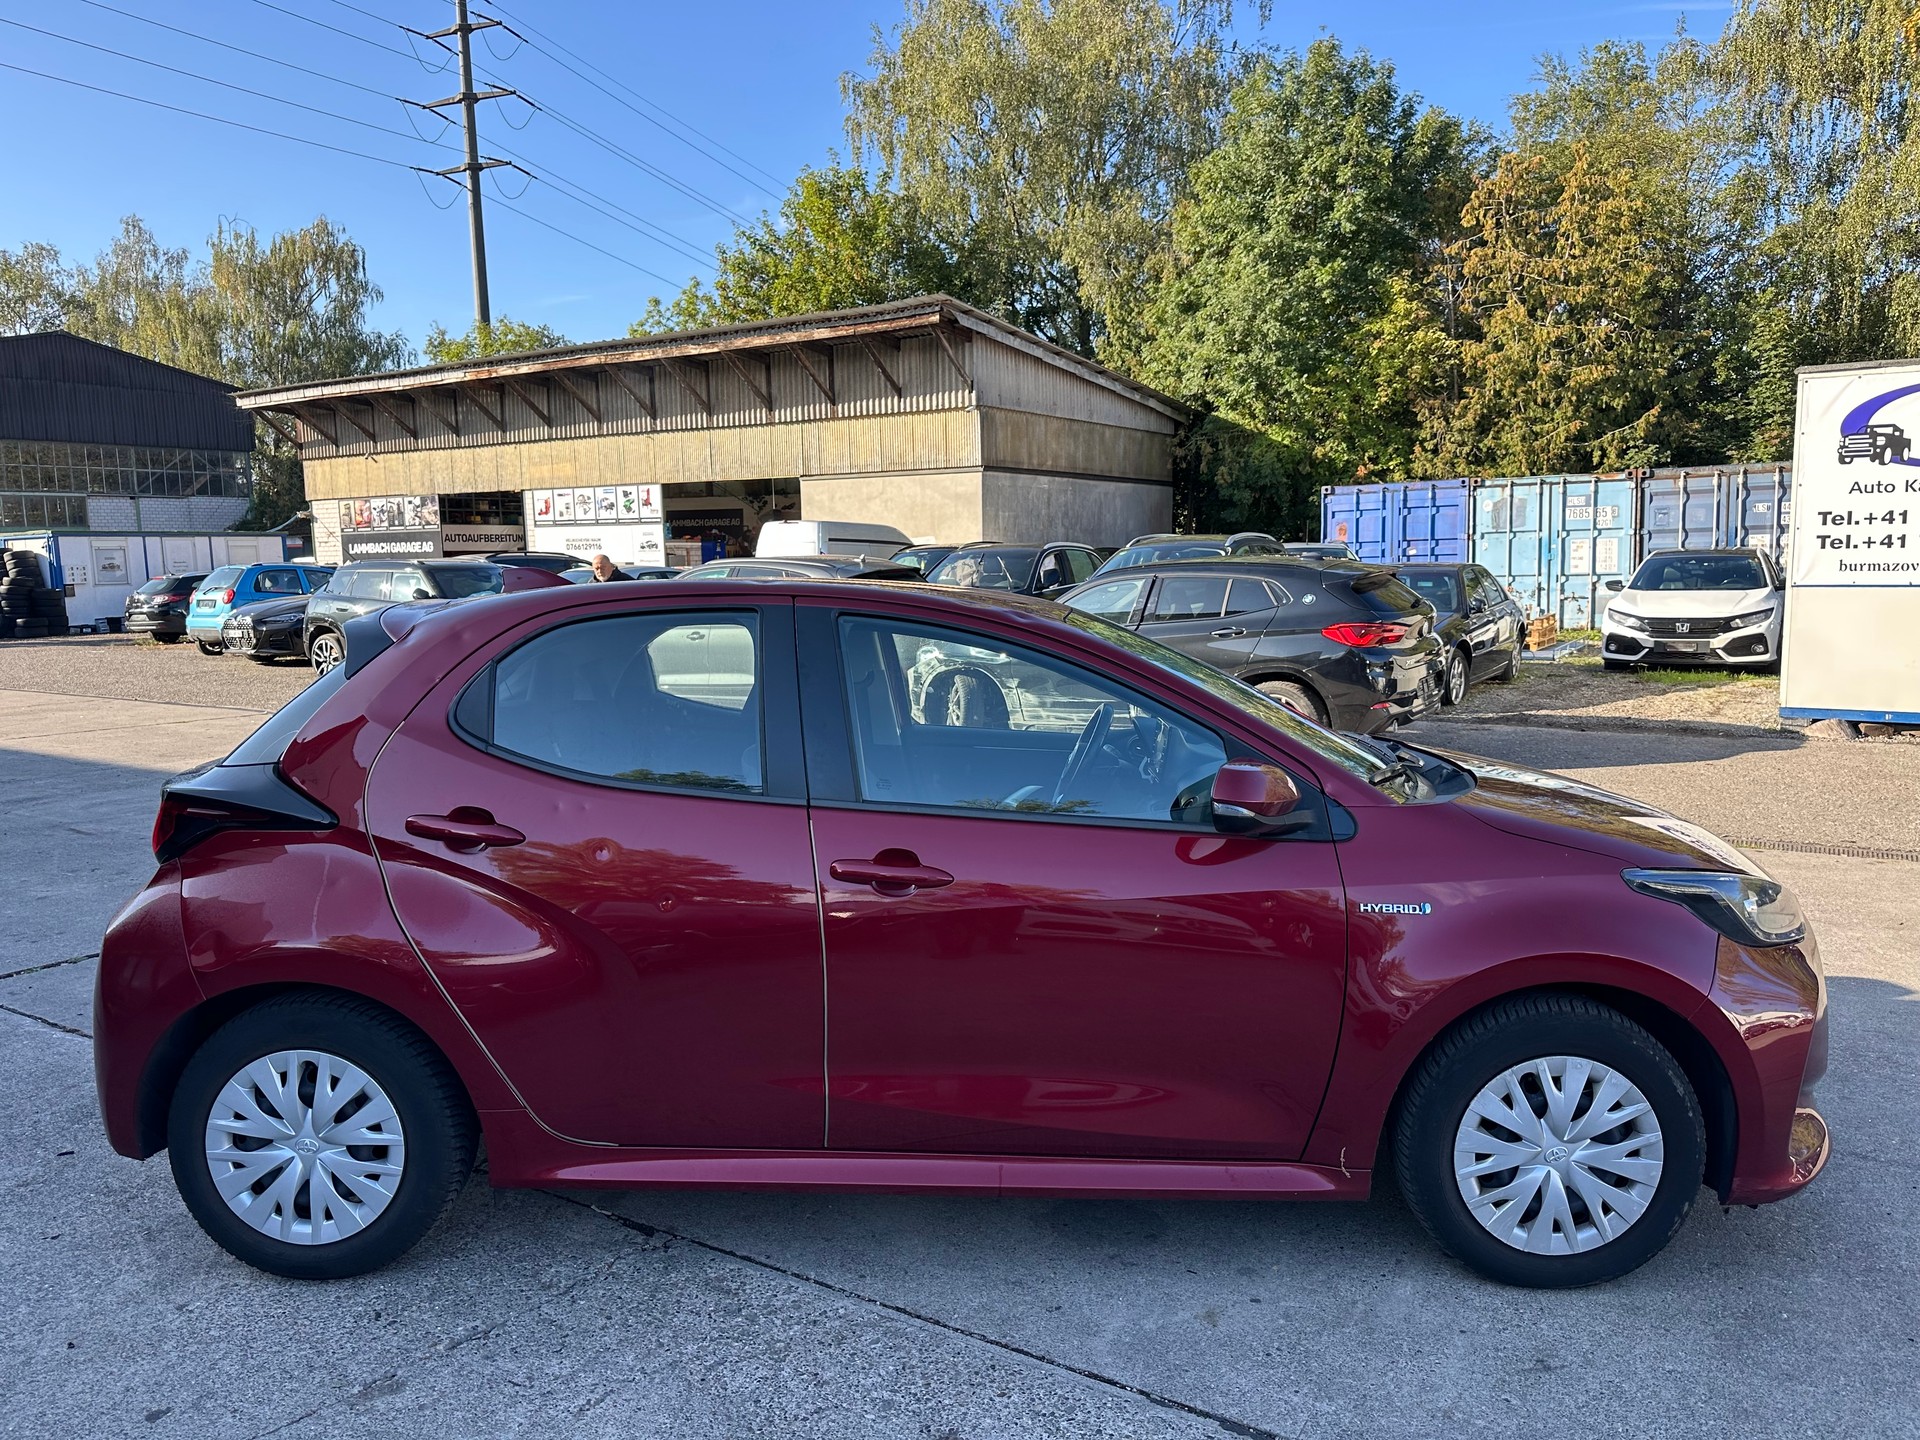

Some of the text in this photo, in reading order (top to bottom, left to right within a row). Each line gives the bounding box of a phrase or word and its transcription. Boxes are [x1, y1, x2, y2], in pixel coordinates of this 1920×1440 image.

[1848, 479, 1920, 494] Auto K
[1567, 507, 1590, 519] 7685
[704, 518, 731, 526] GARAGE
[731, 517, 741, 526] AG
[444, 533, 524, 543] AUTOAUFBEREITUN
[348, 541, 434, 554] LAMMBACH GARAGE AG
[1839, 559, 1920, 572] burmazov
[1360, 903, 1421, 914] HYBRID
